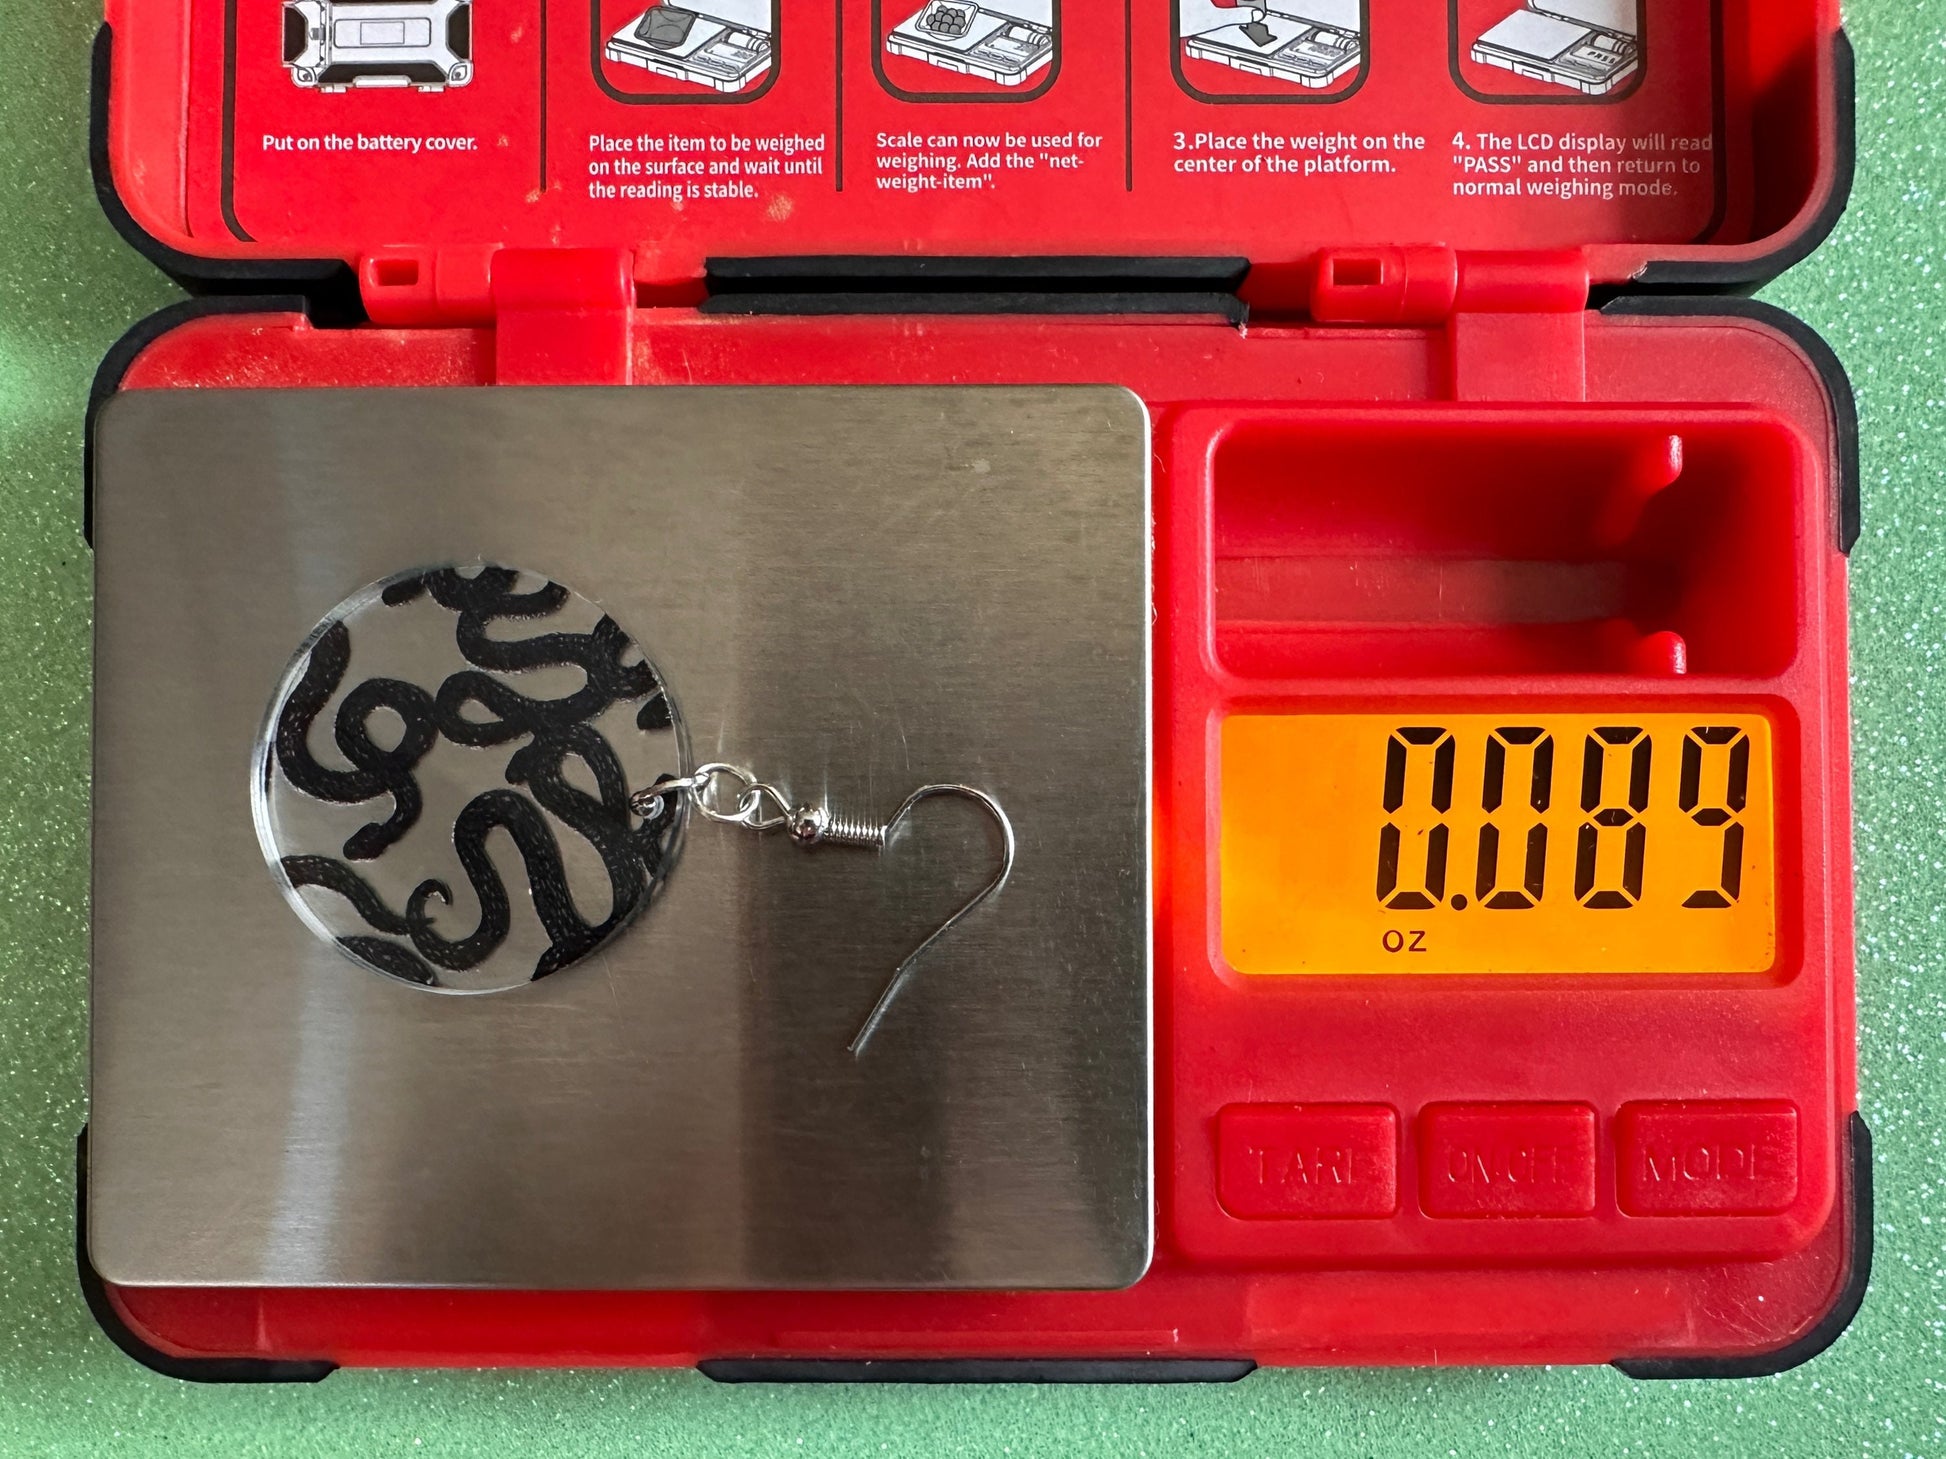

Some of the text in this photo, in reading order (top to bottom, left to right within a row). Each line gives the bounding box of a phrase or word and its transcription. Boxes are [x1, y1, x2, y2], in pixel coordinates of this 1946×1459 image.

[261, 132, 479, 154] Put on the battery cover.
[588, 133, 826, 156] Place the item to be weighed
[876, 131, 1104, 148] Scale can now be used for
[1251, 131, 1286, 150] the
[1289, 131, 1358, 154] weight
[1361, 136, 1388, 150] on
[1392, 131, 1426, 150] the
[1451, 131, 1713, 154] 4. The LCD display will read
[587, 156, 824, 175] on the surface and wait until
[875, 152, 1085, 172] weighing. Add the "net-
[1173, 154, 1397, 176] center of the platform.
[1453, 155, 1701, 173] "PASS" and then return to
[587, 180, 759, 203] the reading is stable.
[875, 173, 996, 193] weight-item".
[1452, 177, 1679, 200] normal weighing mode.
[1376, 726, 1751, 911] 0.089
